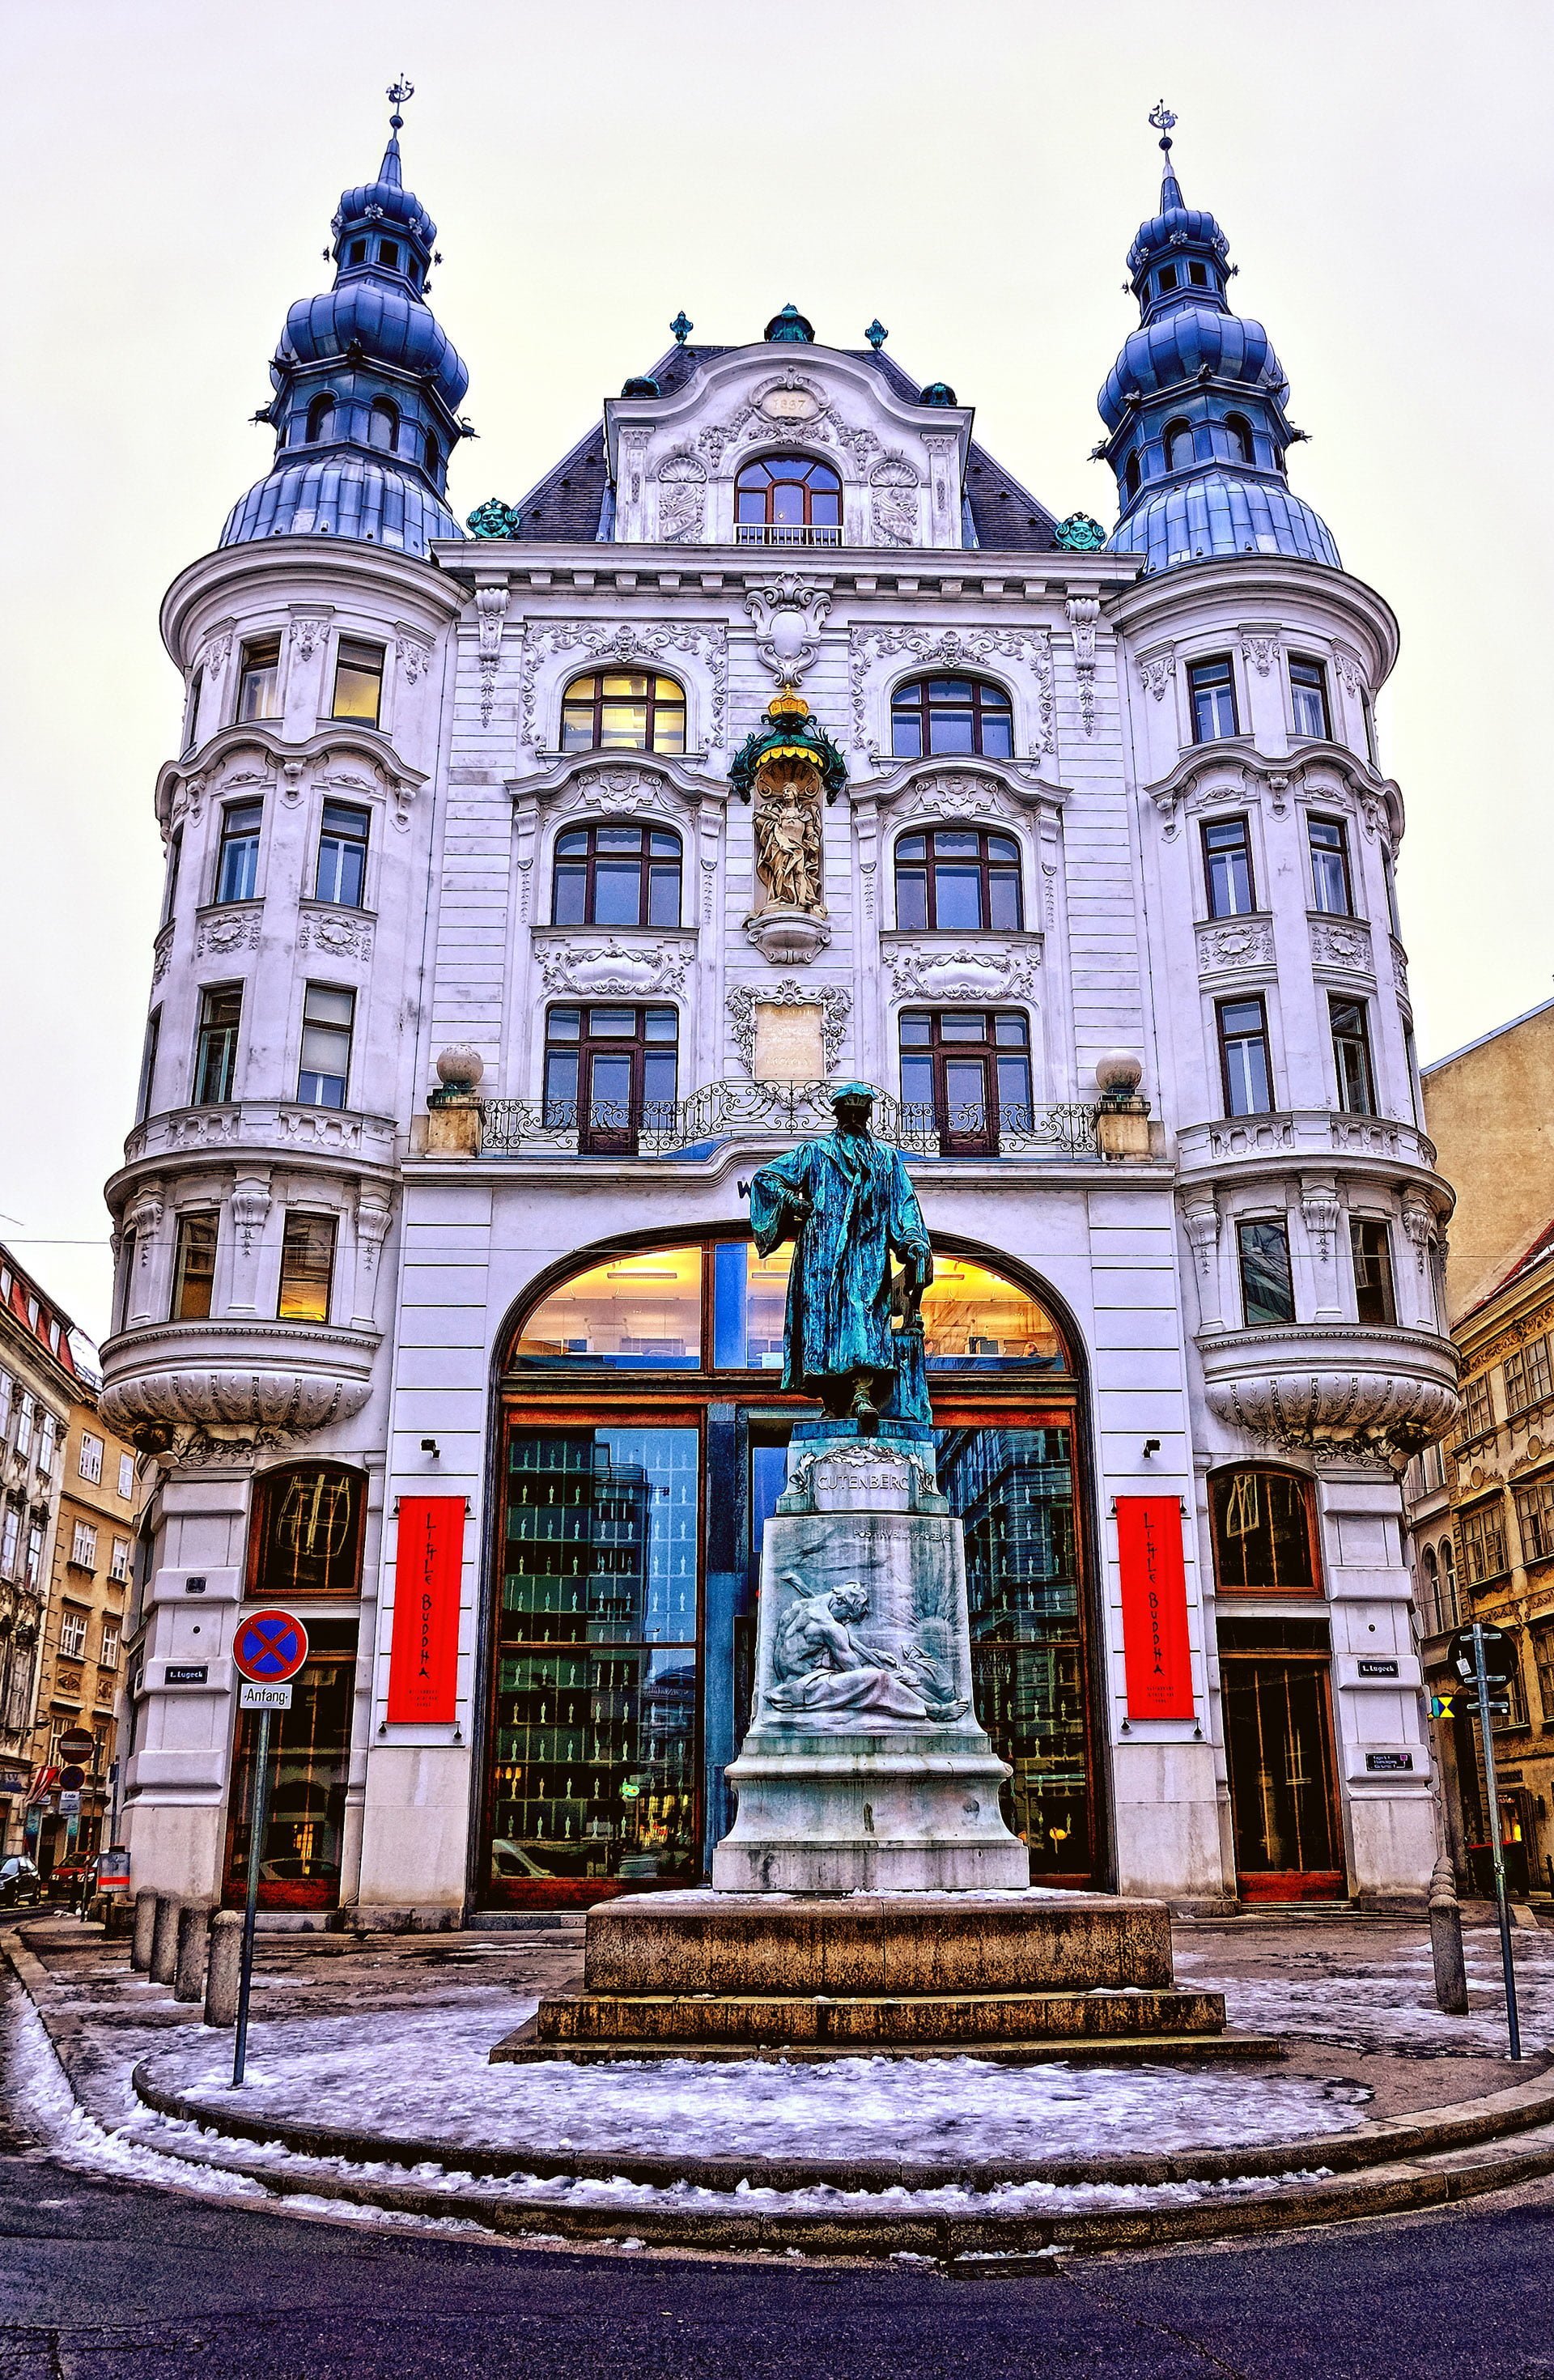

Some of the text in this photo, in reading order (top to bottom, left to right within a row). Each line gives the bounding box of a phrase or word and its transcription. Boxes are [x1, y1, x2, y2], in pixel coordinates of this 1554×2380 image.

[817, 1474, 910, 1491] GUTENBERG
[177, 1671, 203, 1679] Lugeck
[1369, 1665, 1395, 1673] Lugeck
[246, 1688, 286, 1705] Anfang
